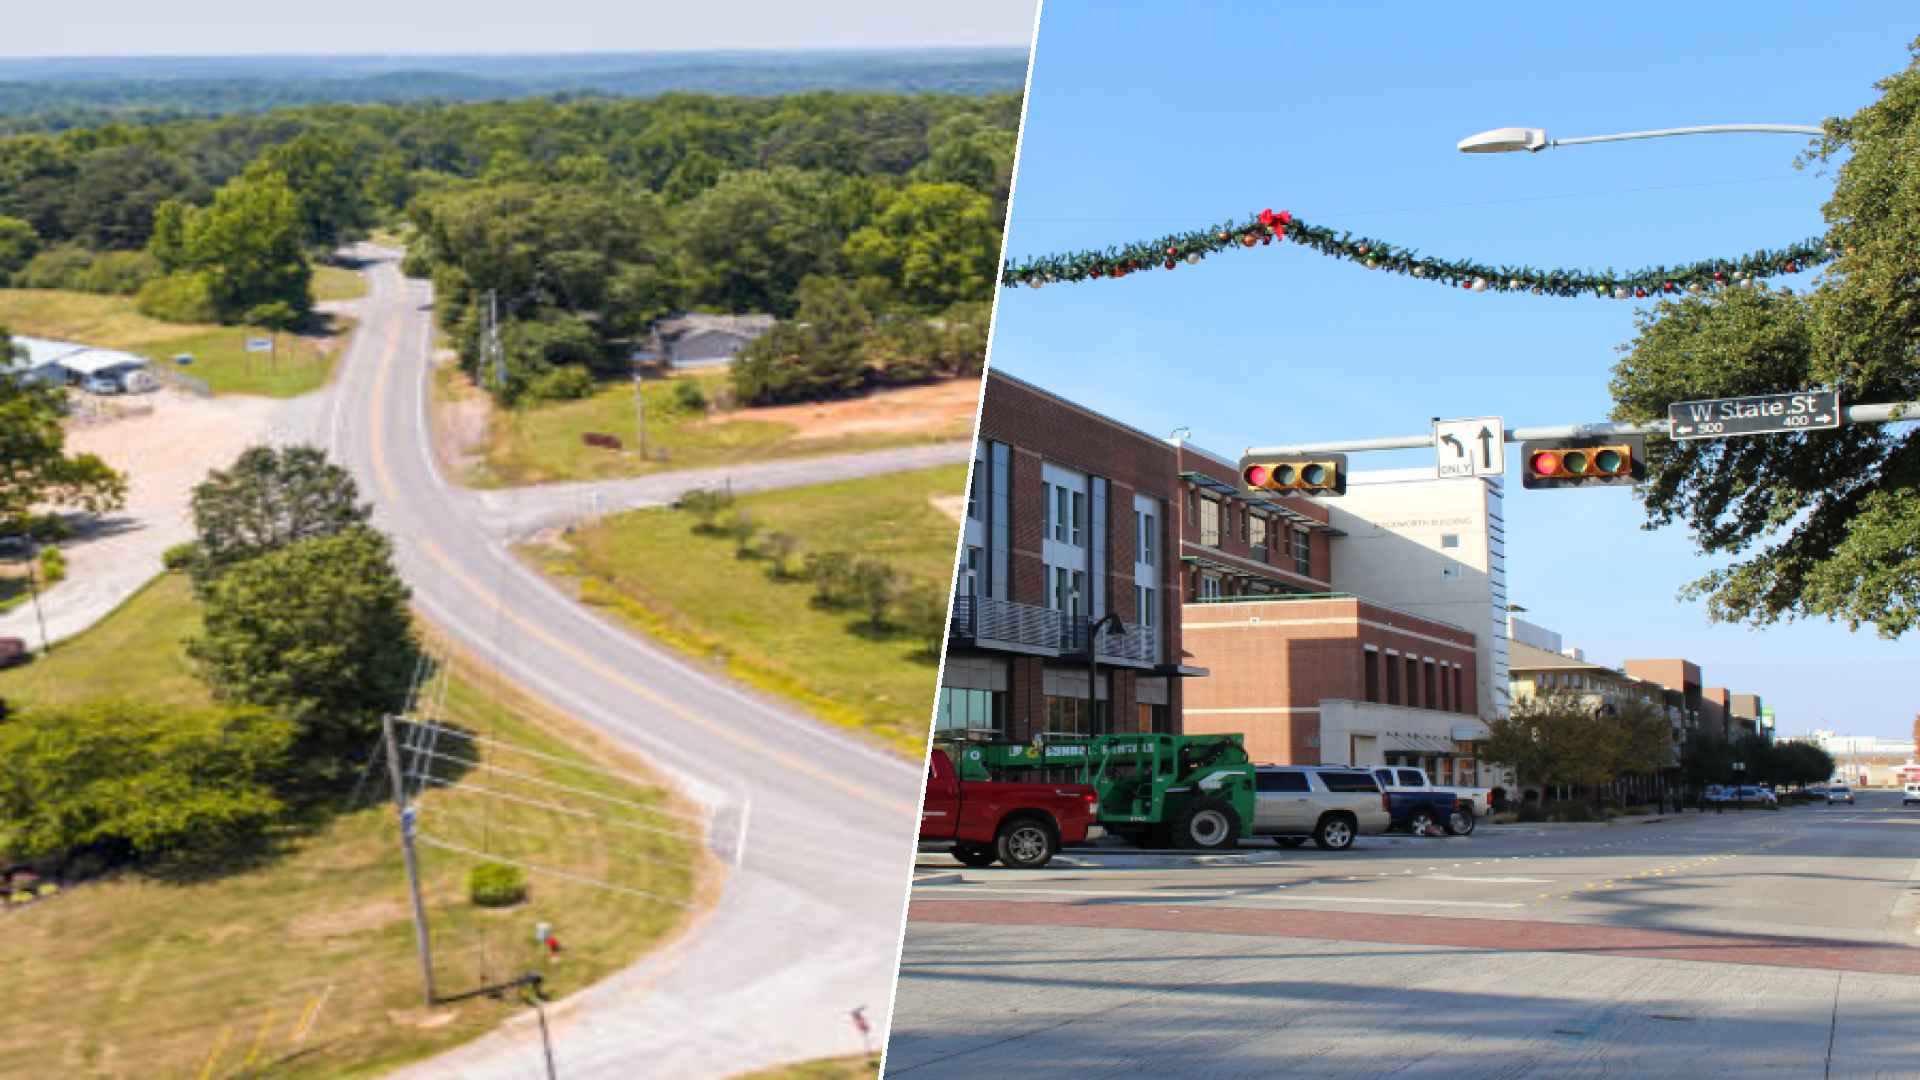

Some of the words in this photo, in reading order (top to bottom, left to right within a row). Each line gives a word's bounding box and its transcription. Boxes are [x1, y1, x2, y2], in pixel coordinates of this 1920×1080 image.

[1690, 404, 1712, 421] W
[1720, 399, 1784, 421] State
[1791, 395, 1817, 413] St
[1783, 415, 1809, 427] 400
[1440, 463, 1471, 474] ONLY
